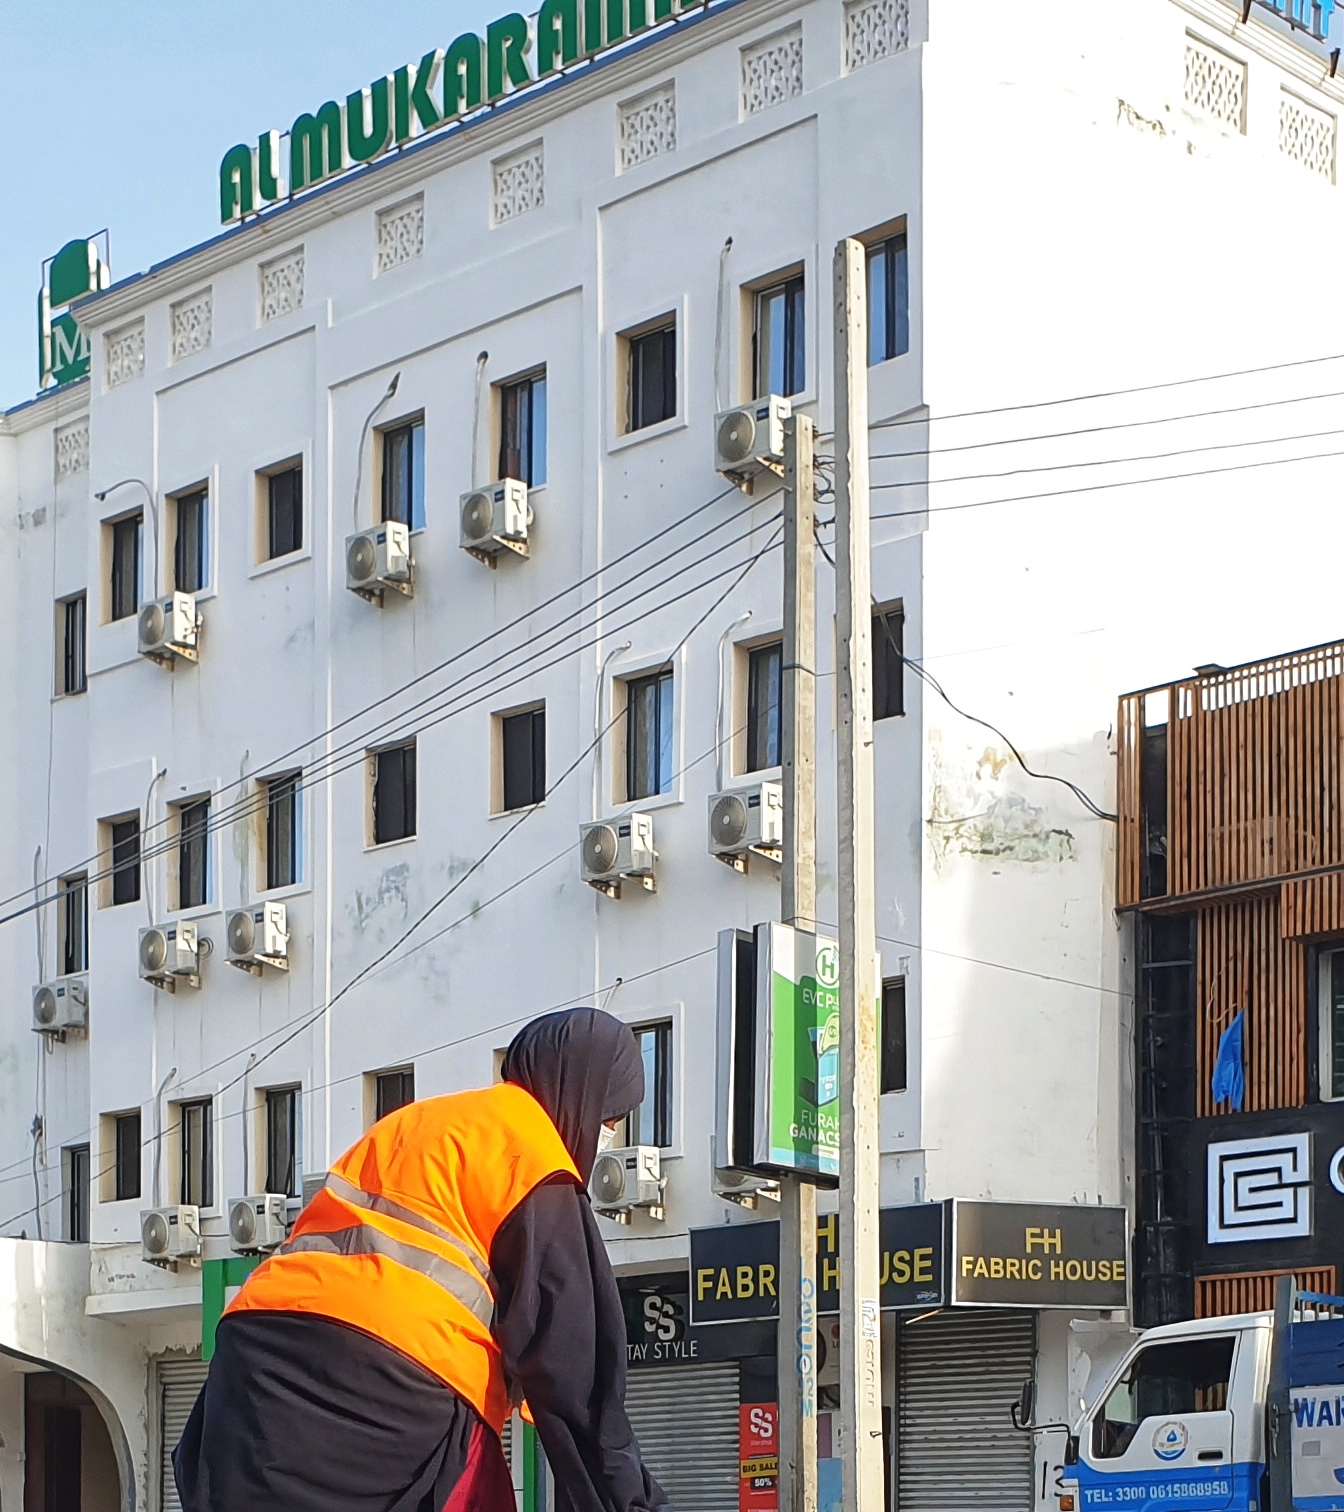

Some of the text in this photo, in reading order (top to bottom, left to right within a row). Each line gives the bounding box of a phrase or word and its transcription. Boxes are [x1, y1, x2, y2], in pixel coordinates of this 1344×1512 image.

[816, 1215, 835, 1253] H
[697, 1246, 934, 1302] FABR HUSE
[961, 1255, 1126, 1281] FABRIC HOUSE
[626, 1339, 699, 1361] TAY STYLE
[742, 1463, 757, 1474] BIG
[1085, 1488, 1113, 1504] TEL:
